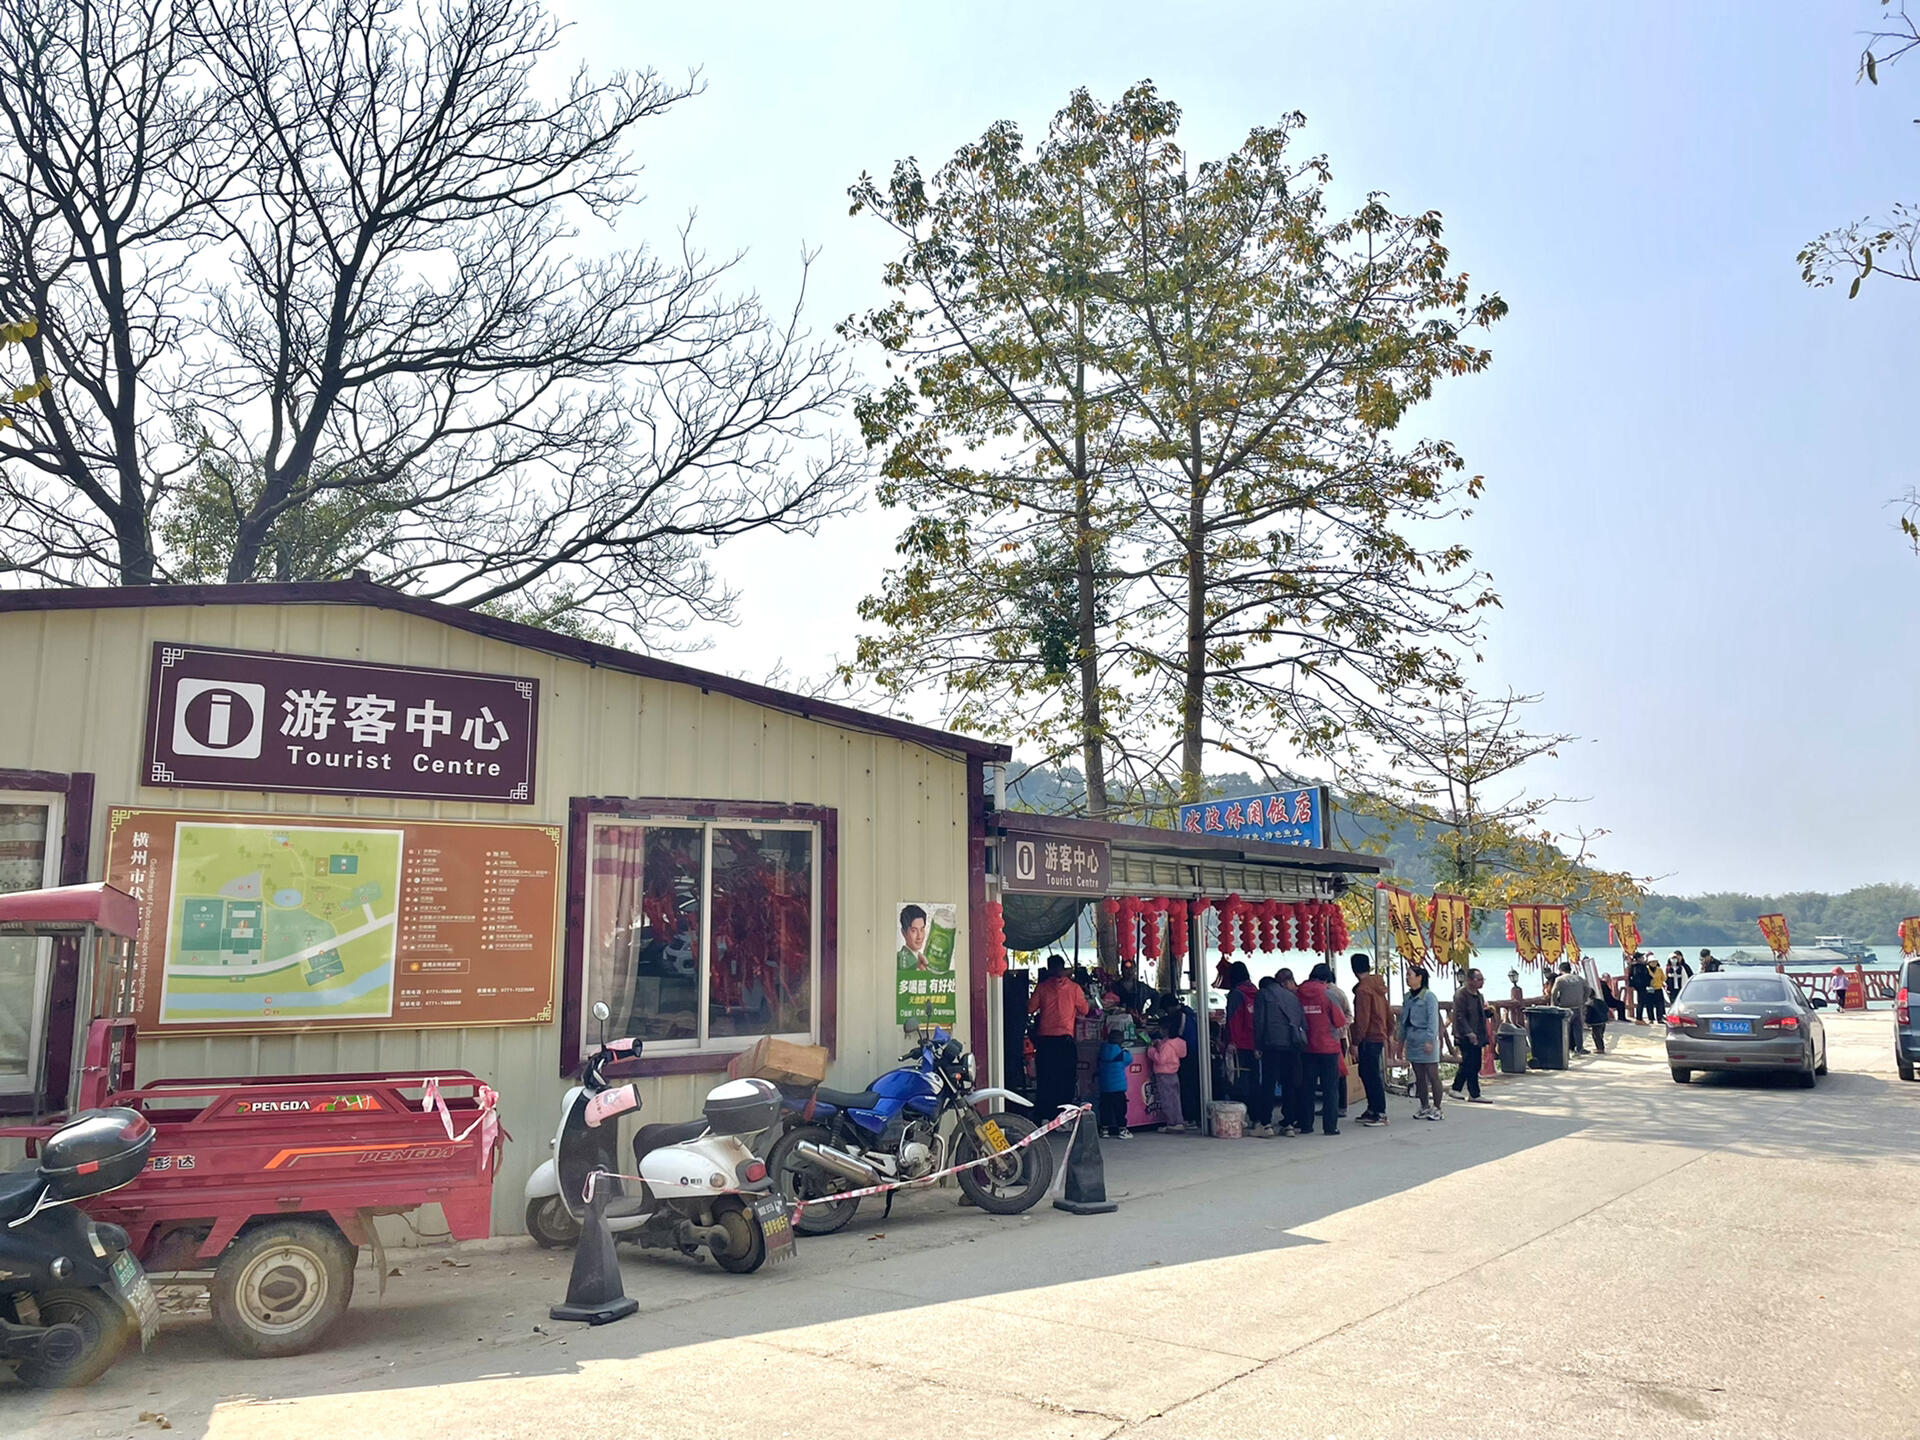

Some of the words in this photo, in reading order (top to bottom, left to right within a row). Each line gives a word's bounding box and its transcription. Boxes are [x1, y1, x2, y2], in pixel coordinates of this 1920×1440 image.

[279, 688, 510, 752] 游客中心
[287, 745, 392, 771] Tourist
[412, 754, 502, 777] Centre
[1184, 791, 1312, 834] 伏波休闲饭店
[1045, 842, 1099, 873] 游客中心
[1046, 874, 1072, 886] Tourist
[1076, 876, 1099, 888] Centre
[1541, 922, 1560, 941] 漢
[251, 1100, 310, 1112] PENGDA
[153, 1154, 195, 1171] 彭达
